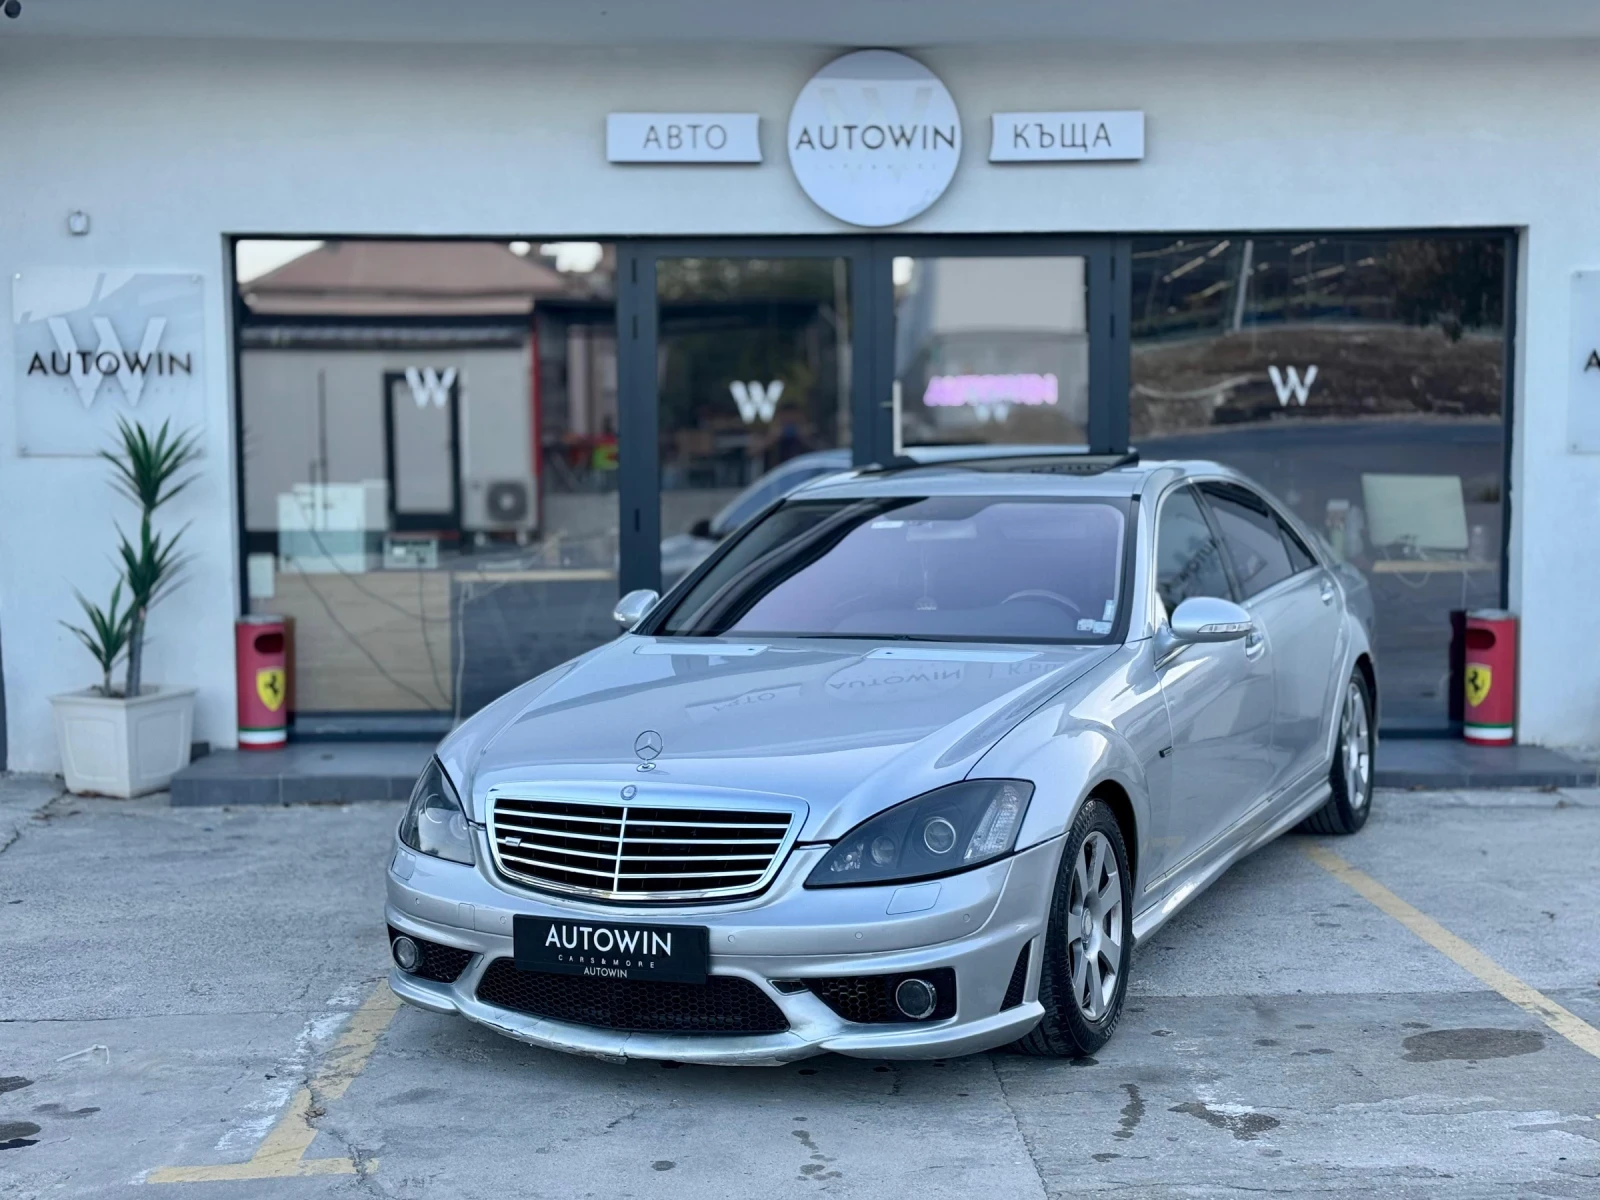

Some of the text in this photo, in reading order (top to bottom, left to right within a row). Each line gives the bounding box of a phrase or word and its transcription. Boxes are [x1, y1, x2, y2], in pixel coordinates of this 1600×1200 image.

[643, 124, 727, 150] АВТО
[795, 125, 955, 150] AUTOWIN
[1014, 122, 1112, 153] КЪЩА
[27, 350, 192, 376] AUTOWIN
[405, 366, 456, 408] W
[1267, 364, 1319, 407] W
[729, 379, 784, 423] W
[545, 924, 672, 956] AUTOWIN
[558, 954, 655, 969] CARS&MORE
[583, 966, 628, 979] AUTOWIN
